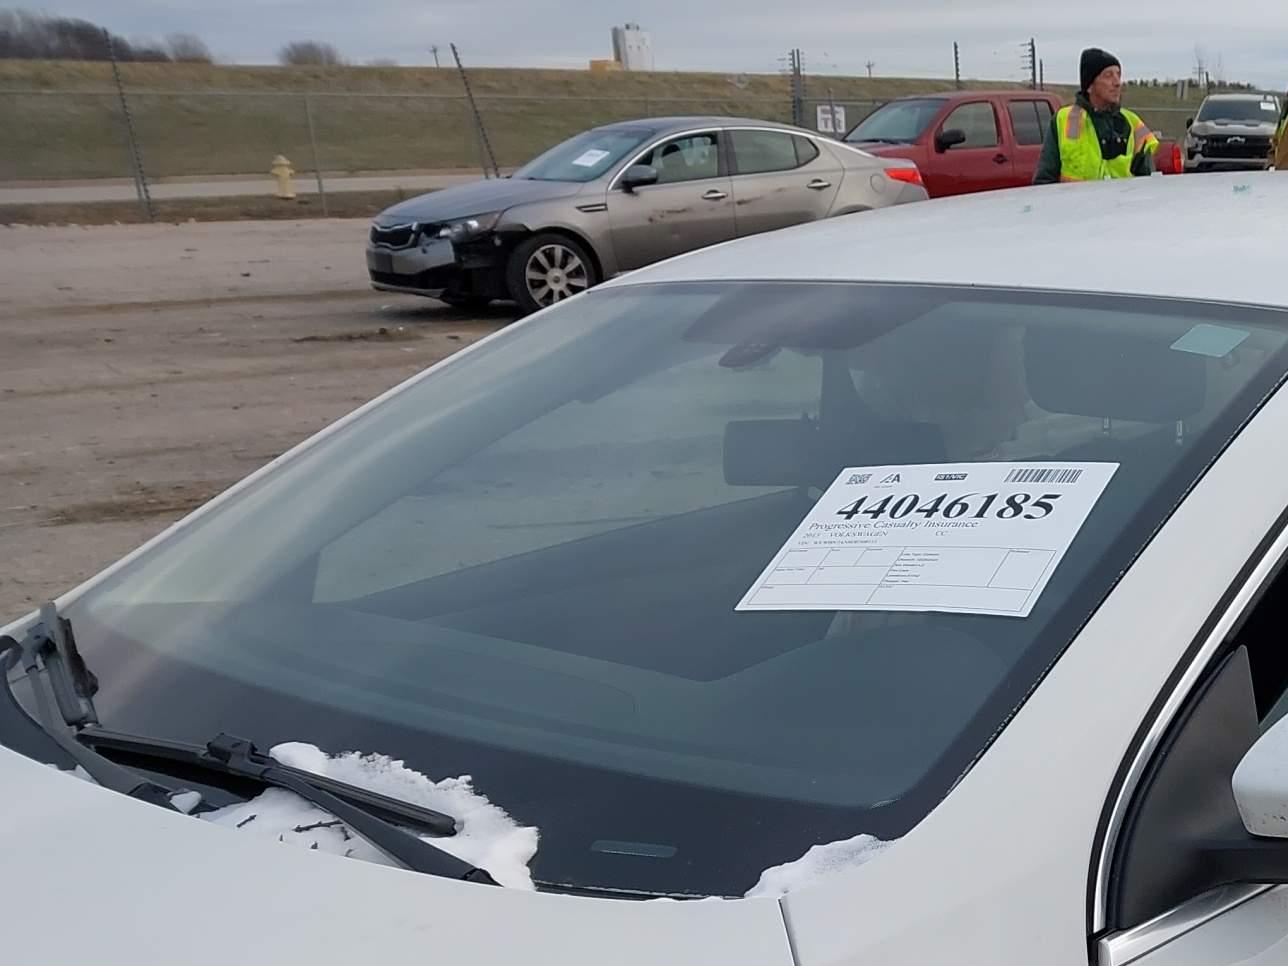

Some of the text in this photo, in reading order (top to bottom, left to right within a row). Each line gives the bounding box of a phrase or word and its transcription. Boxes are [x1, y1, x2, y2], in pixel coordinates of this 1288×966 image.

[836, 492, 1063, 520] 44046185
[808, 520, 979, 531] Progressive Casualty Insurance
[829, 530, 889, 538] VOLKSWAGEN
